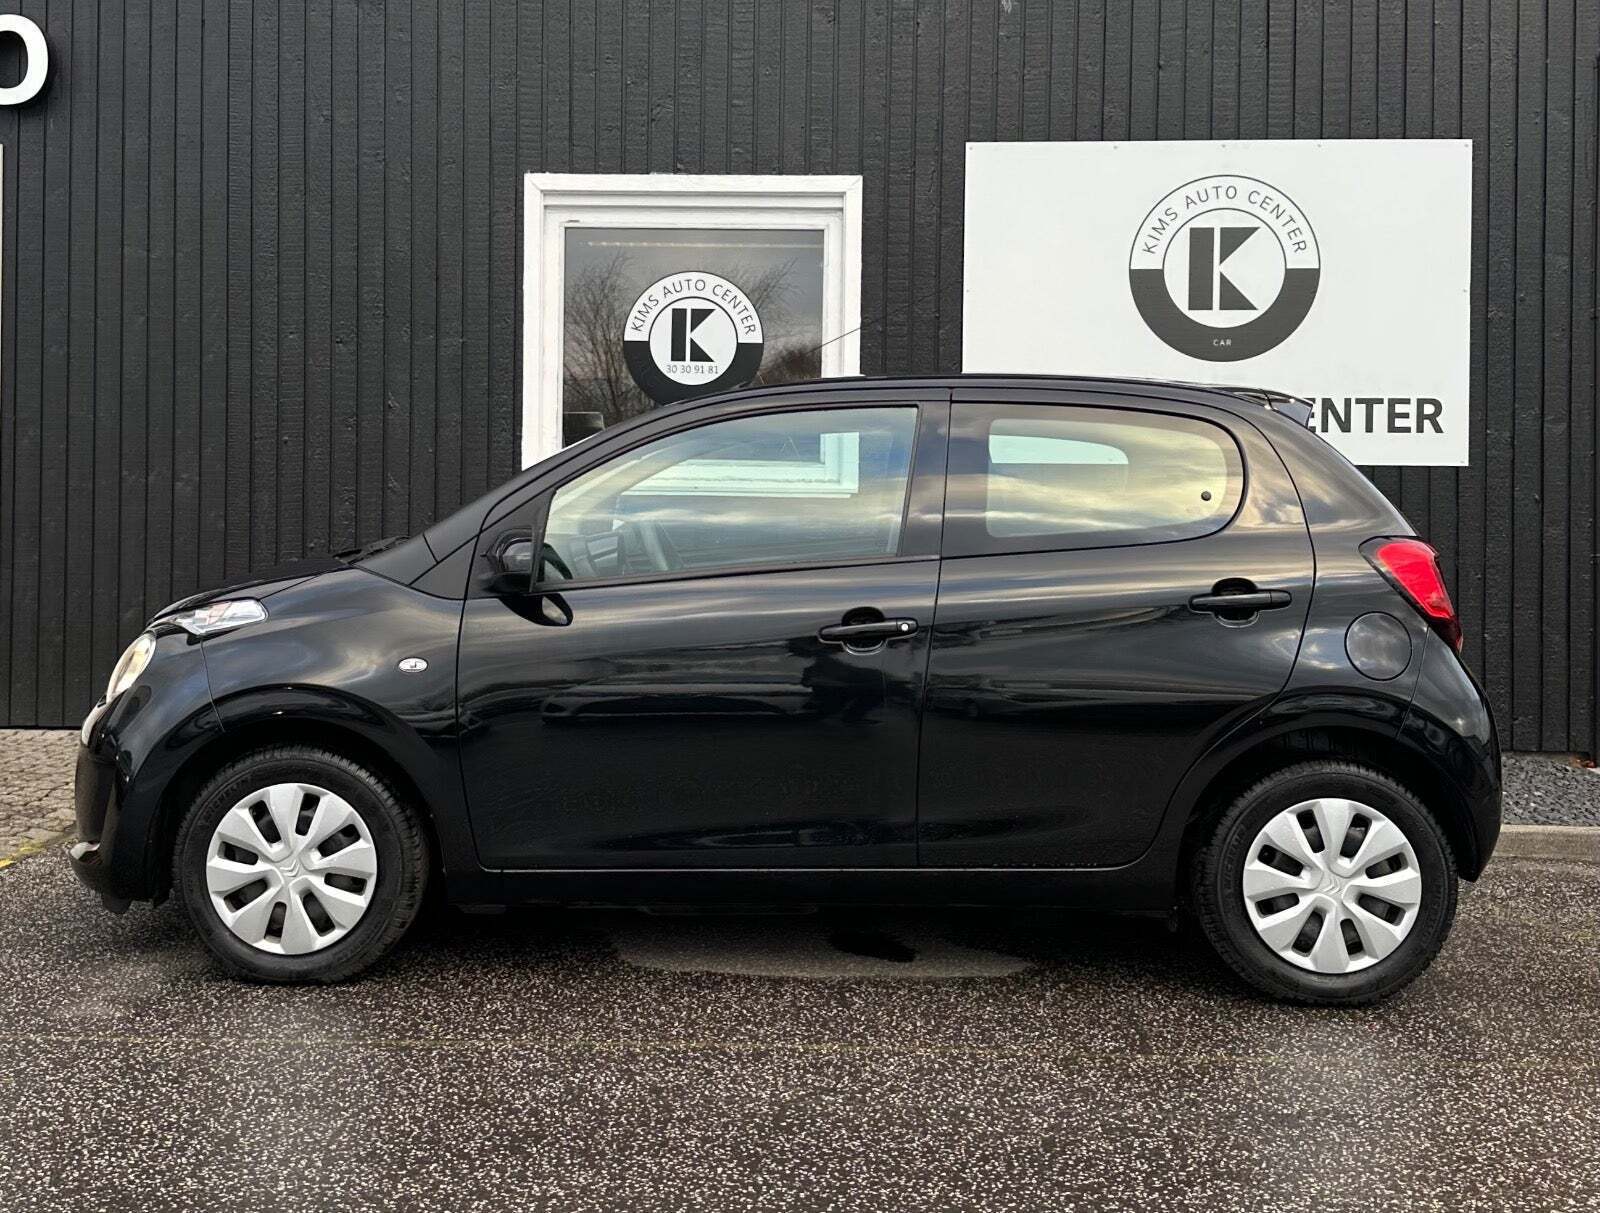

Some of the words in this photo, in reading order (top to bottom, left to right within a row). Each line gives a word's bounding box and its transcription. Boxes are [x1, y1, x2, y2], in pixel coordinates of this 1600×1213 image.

[1142, 207, 1178, 254] KIMS
[1185, 185, 1238, 209] AUTO
[1248, 190, 1307, 253] CENTER
[1188, 226, 1261, 310] K
[631, 294, 660, 332] KIMS
[663, 279, 706, 298] AUTO
[712, 284, 756, 335] CENTER
[670, 308, 717, 362] K
[1212, 338, 1232, 347] CAR
[666, 364, 678, 374] 30
[680, 364, 692, 374] 30
[694, 364, 705, 374] 91
[707, 364, 719, 375] 81
